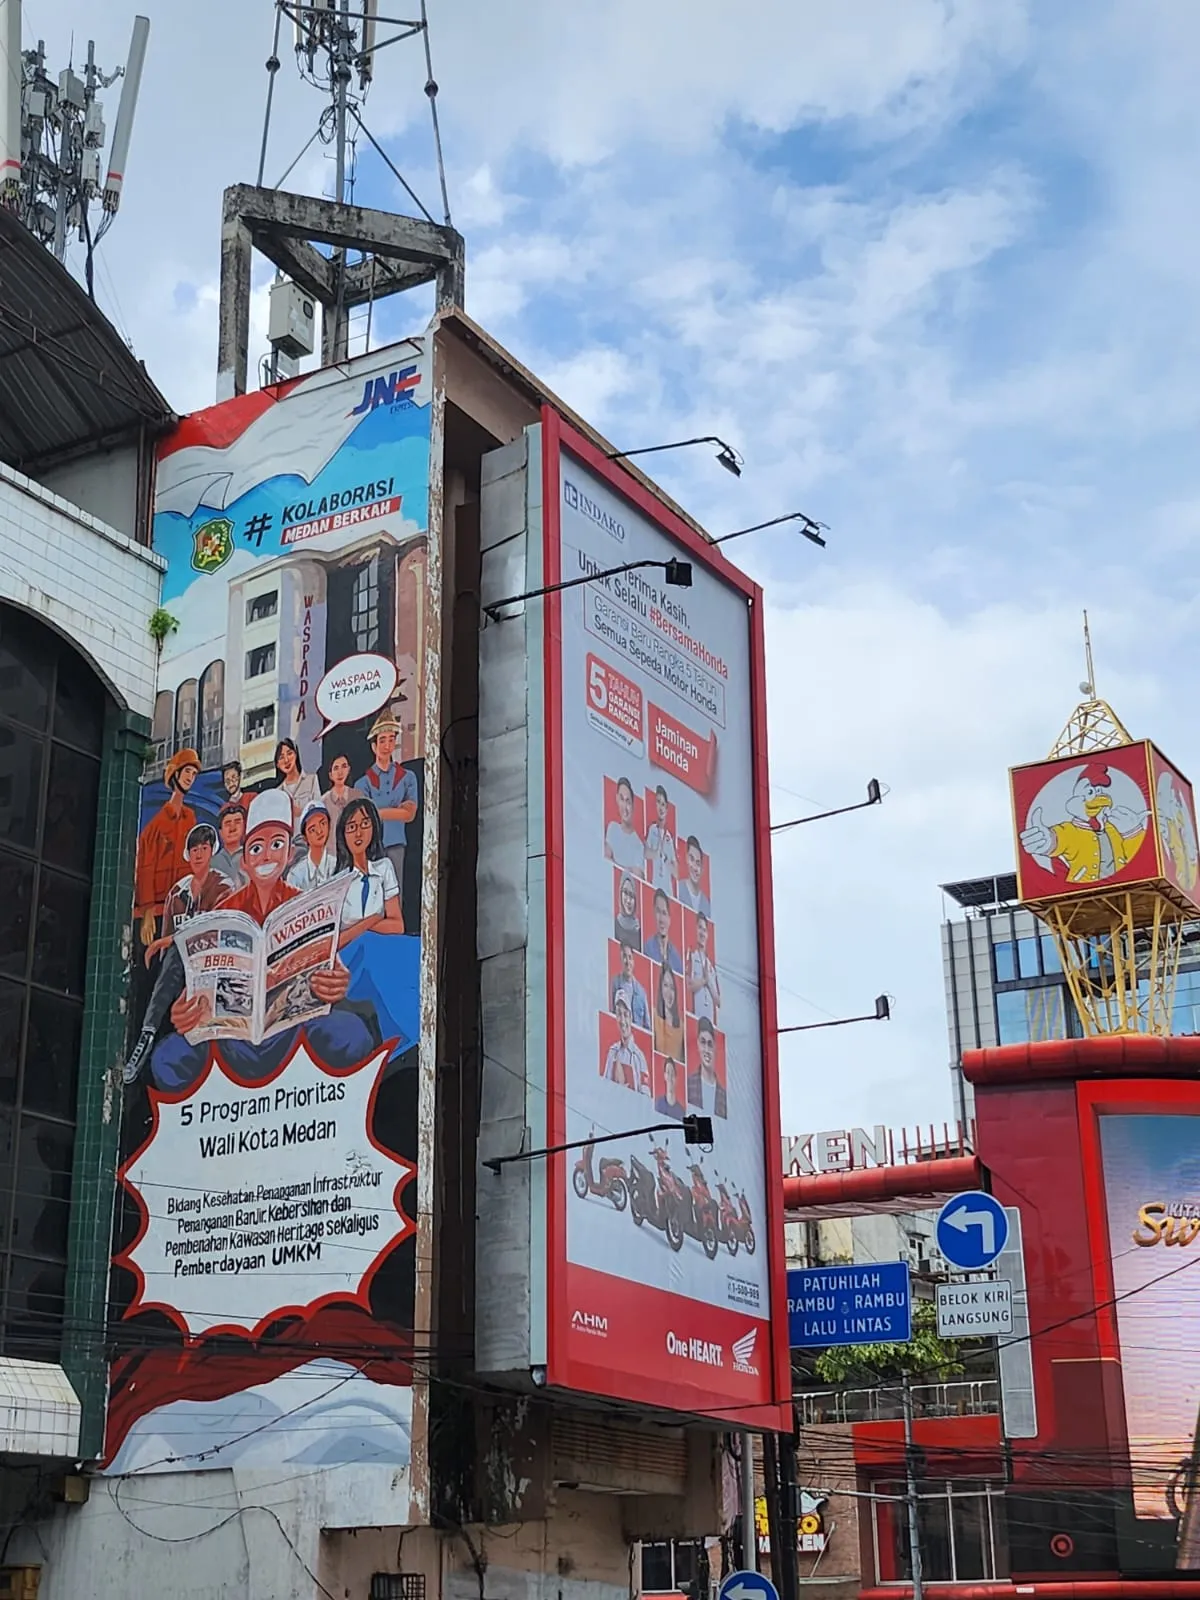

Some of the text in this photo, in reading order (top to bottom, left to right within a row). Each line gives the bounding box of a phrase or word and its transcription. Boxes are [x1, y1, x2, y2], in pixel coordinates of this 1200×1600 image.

[352, 364, 422, 416] JNE
[243, 512, 273, 547] #
[281, 477, 394, 525] KOLABORASI
[284, 500, 392, 544] MEDAN BERKAH
[579, 491, 625, 541] INDAKO
[660, 590, 690, 629] Kasih.
[594, 595, 629, 631] Garansi
[631, 622, 651, 648] Baru
[684, 663, 692, 678] 5
[614, 578, 647, 617] Selalu
[649, 606, 728, 679] #BersamaHonda
[296, 594, 313, 722] WASPADA
[594, 614, 717, 715] Semua Sepeda Motor Honda
[331, 669, 381, 690] WASPADA
[363, 680, 381, 693] ADA
[589, 660, 608, 709] 5
[608, 691, 640, 720] GARANSI
[608, 703, 639, 732] RANGKA
[655, 717, 698, 759] Jaminan
[655, 736, 689, 773] Honda
[272, 905, 333, 944] WASPADA
[181, 1081, 346, 1126] 5 Program Prioritas
[200, 1119, 336, 1158] Wali Kota Medan
[167, 1197, 201, 1215] Bidang
[268, 1198, 329, 1221] Kebersihan
[331, 1194, 351, 1213] dan
[165, 1235, 228, 1257] Pembenahan
[229, 1229, 275, 1249] Kawasan
[277, 1221, 324, 1243] Heritage
[174, 1241, 321, 1278] Pemberdayaan UMKM
[803, 1273, 881, 1292] PATUHILAH
[939, 1290, 1009, 1306] BELOK KIRI
[571, 1310, 608, 1330] AHM
[787, 1296, 835, 1313] RAMBU
[854, 1292, 905, 1309] RAMBU
[941, 1309, 1009, 1326] LANGSUNG
[803, 1316, 892, 1337] LALU LINTAS
[666, 1331, 723, 1367] One HEART.
